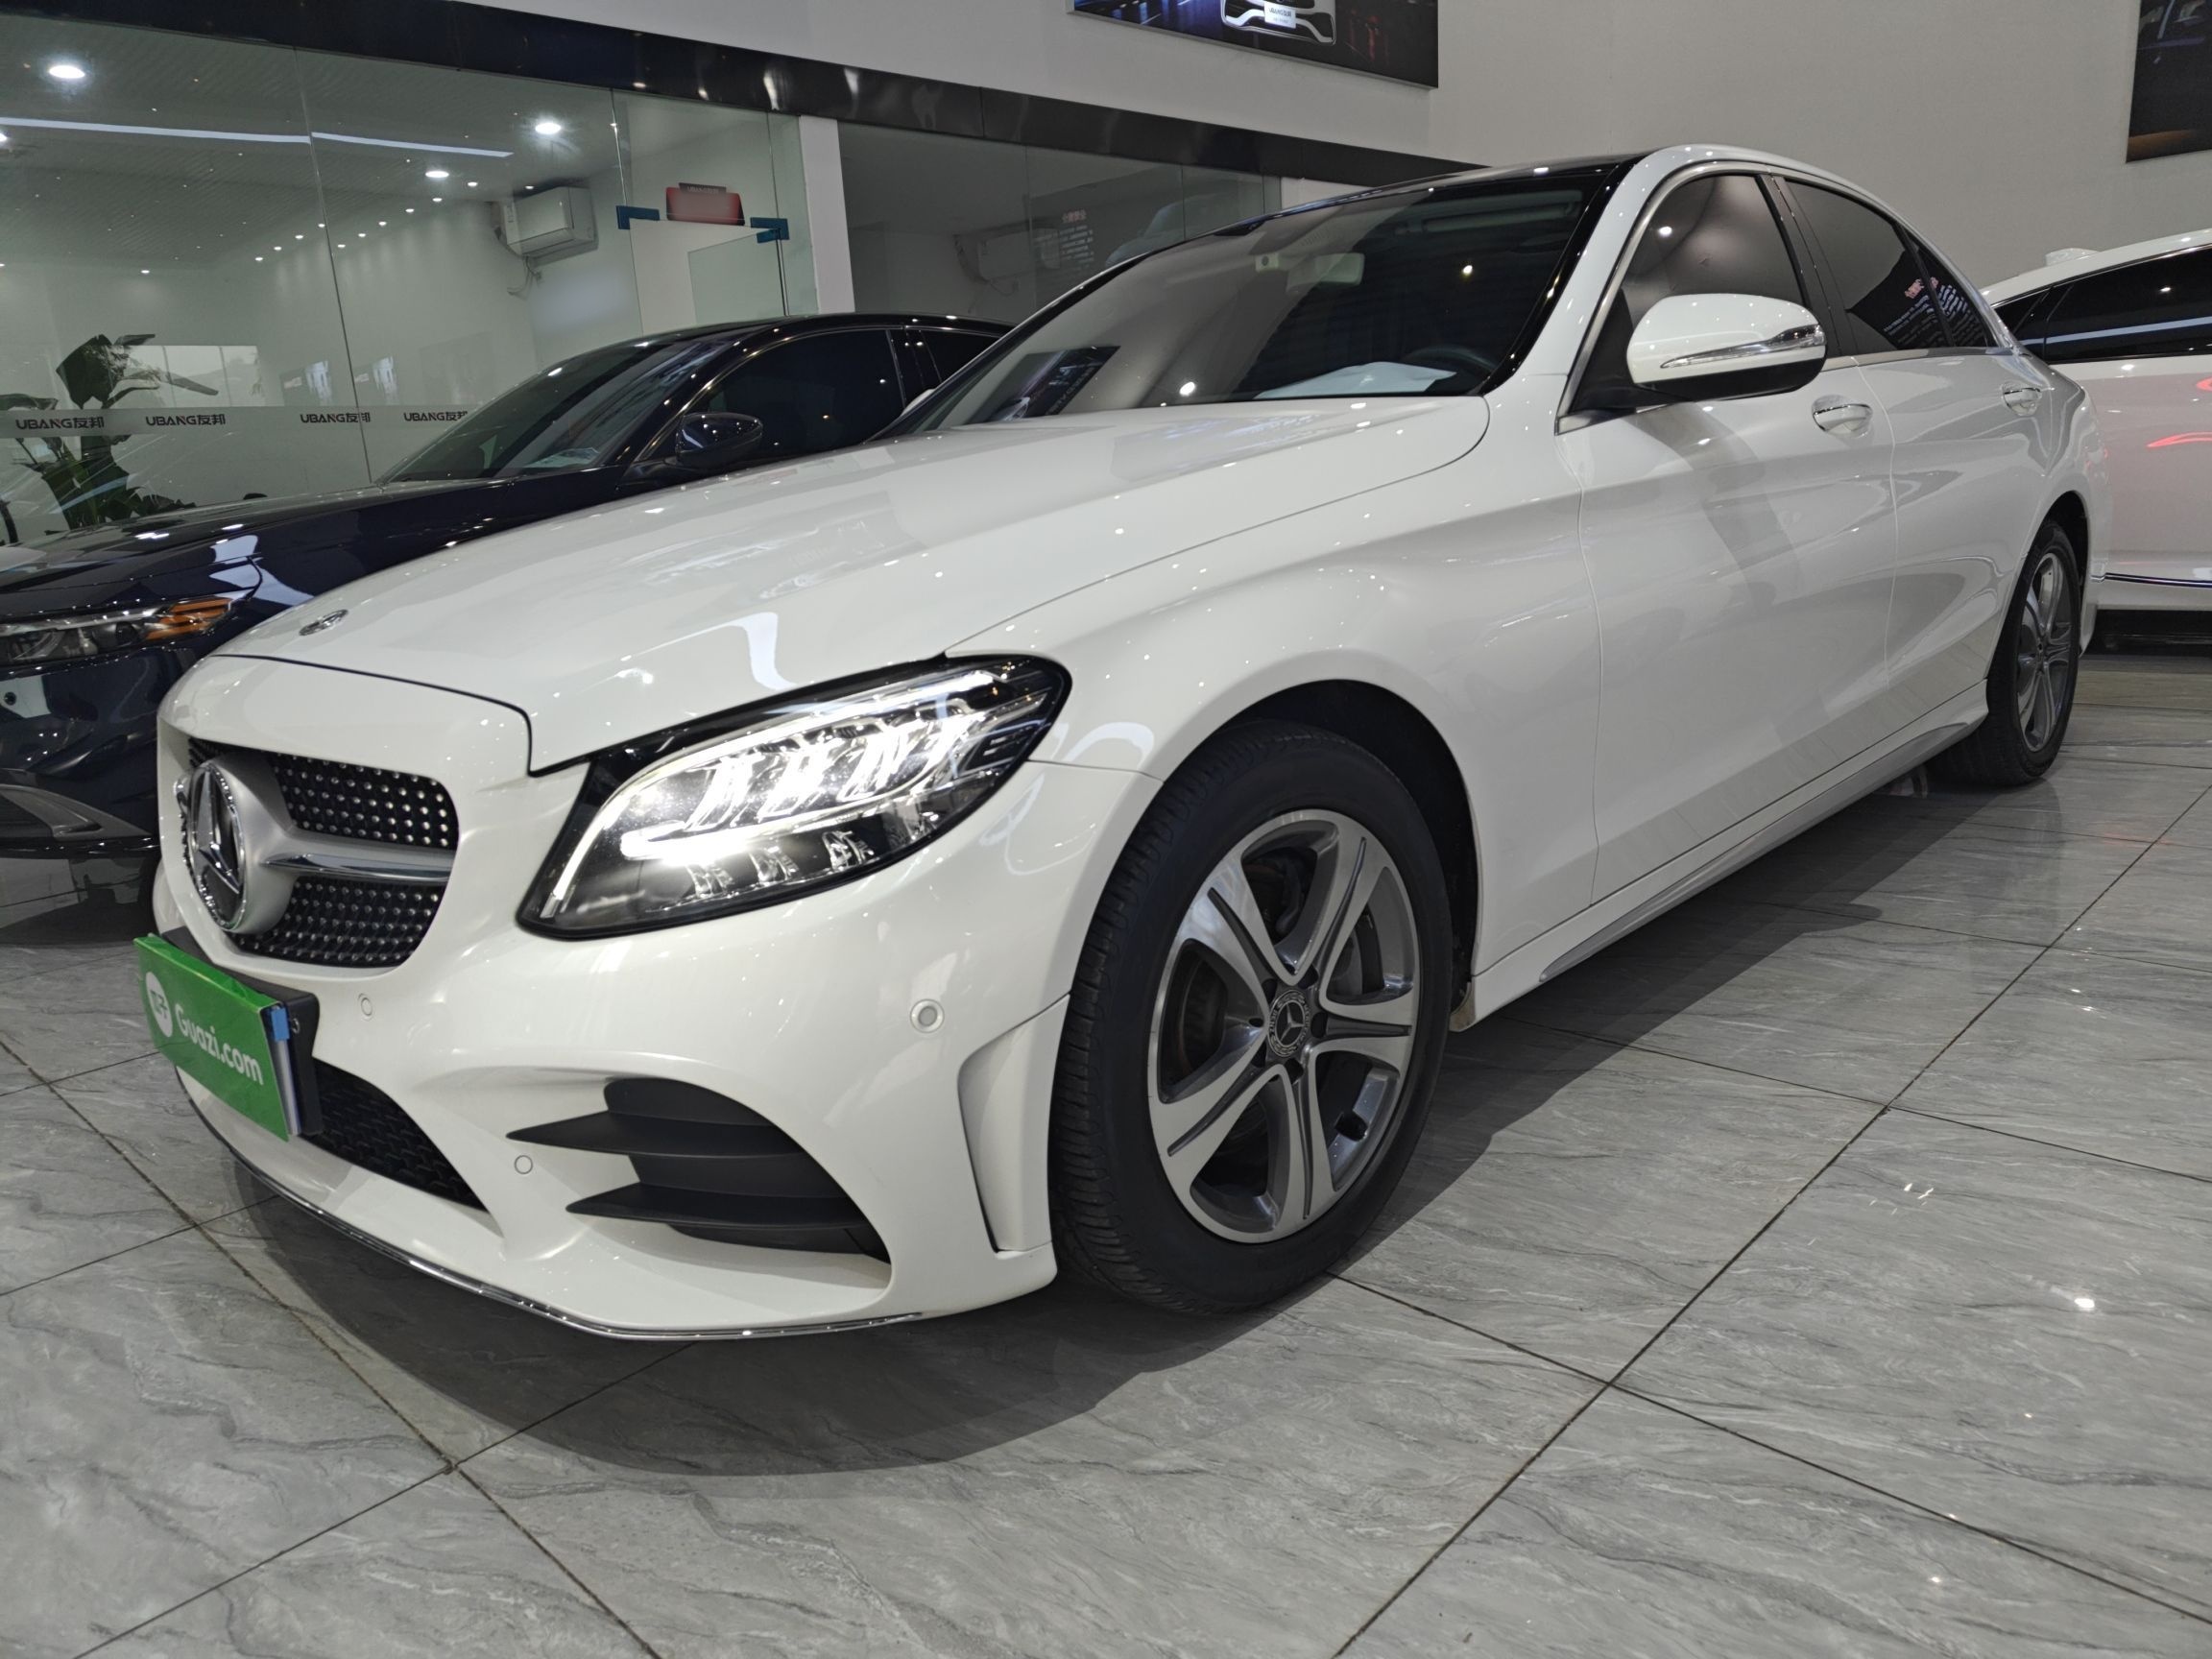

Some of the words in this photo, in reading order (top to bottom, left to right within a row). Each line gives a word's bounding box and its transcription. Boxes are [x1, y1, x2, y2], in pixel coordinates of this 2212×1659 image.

[15, 416, 105, 429] UBANG友邦
[146, 414, 226, 425] UBANG友邦
[176, 1003, 264, 1086] Guazi.com
